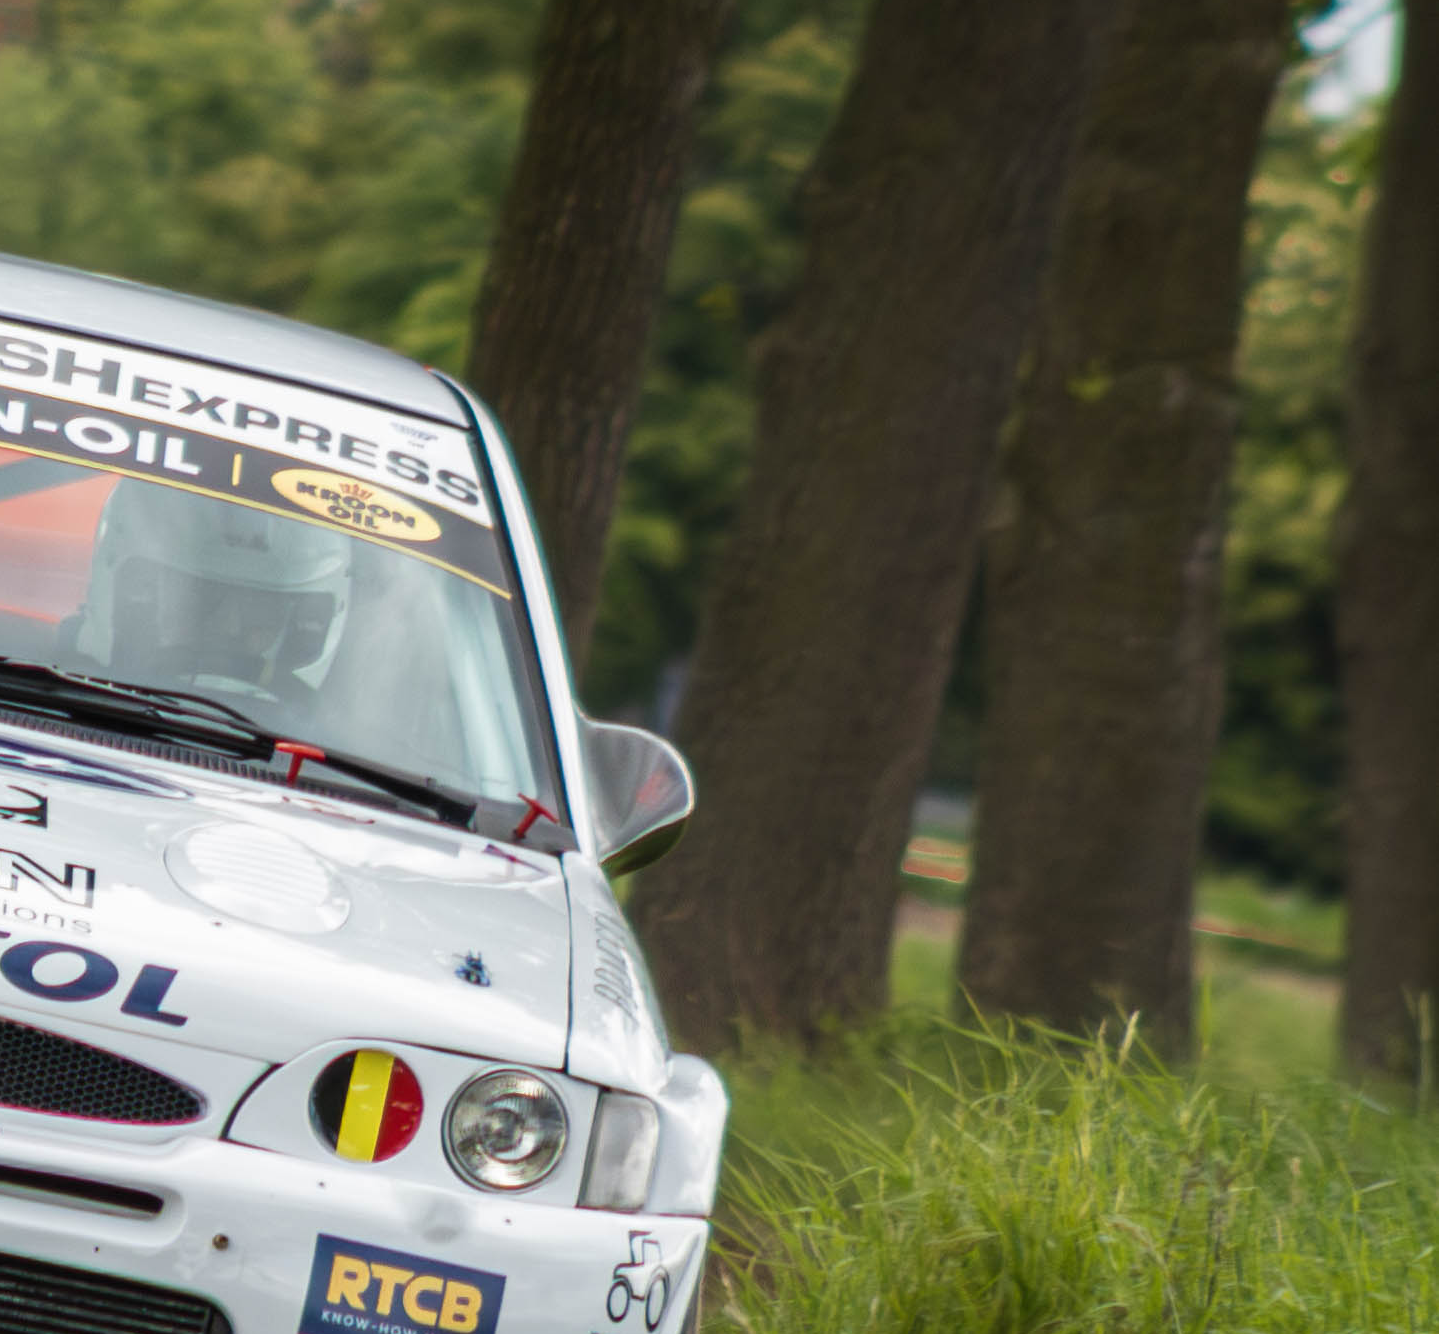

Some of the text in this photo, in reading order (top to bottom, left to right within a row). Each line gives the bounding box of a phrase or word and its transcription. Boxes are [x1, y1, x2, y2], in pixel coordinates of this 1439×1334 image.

[296, 481, 416, 529] KROON
[328, 504, 379, 530] OIL
[326, 1253, 483, 1334] RTCB
